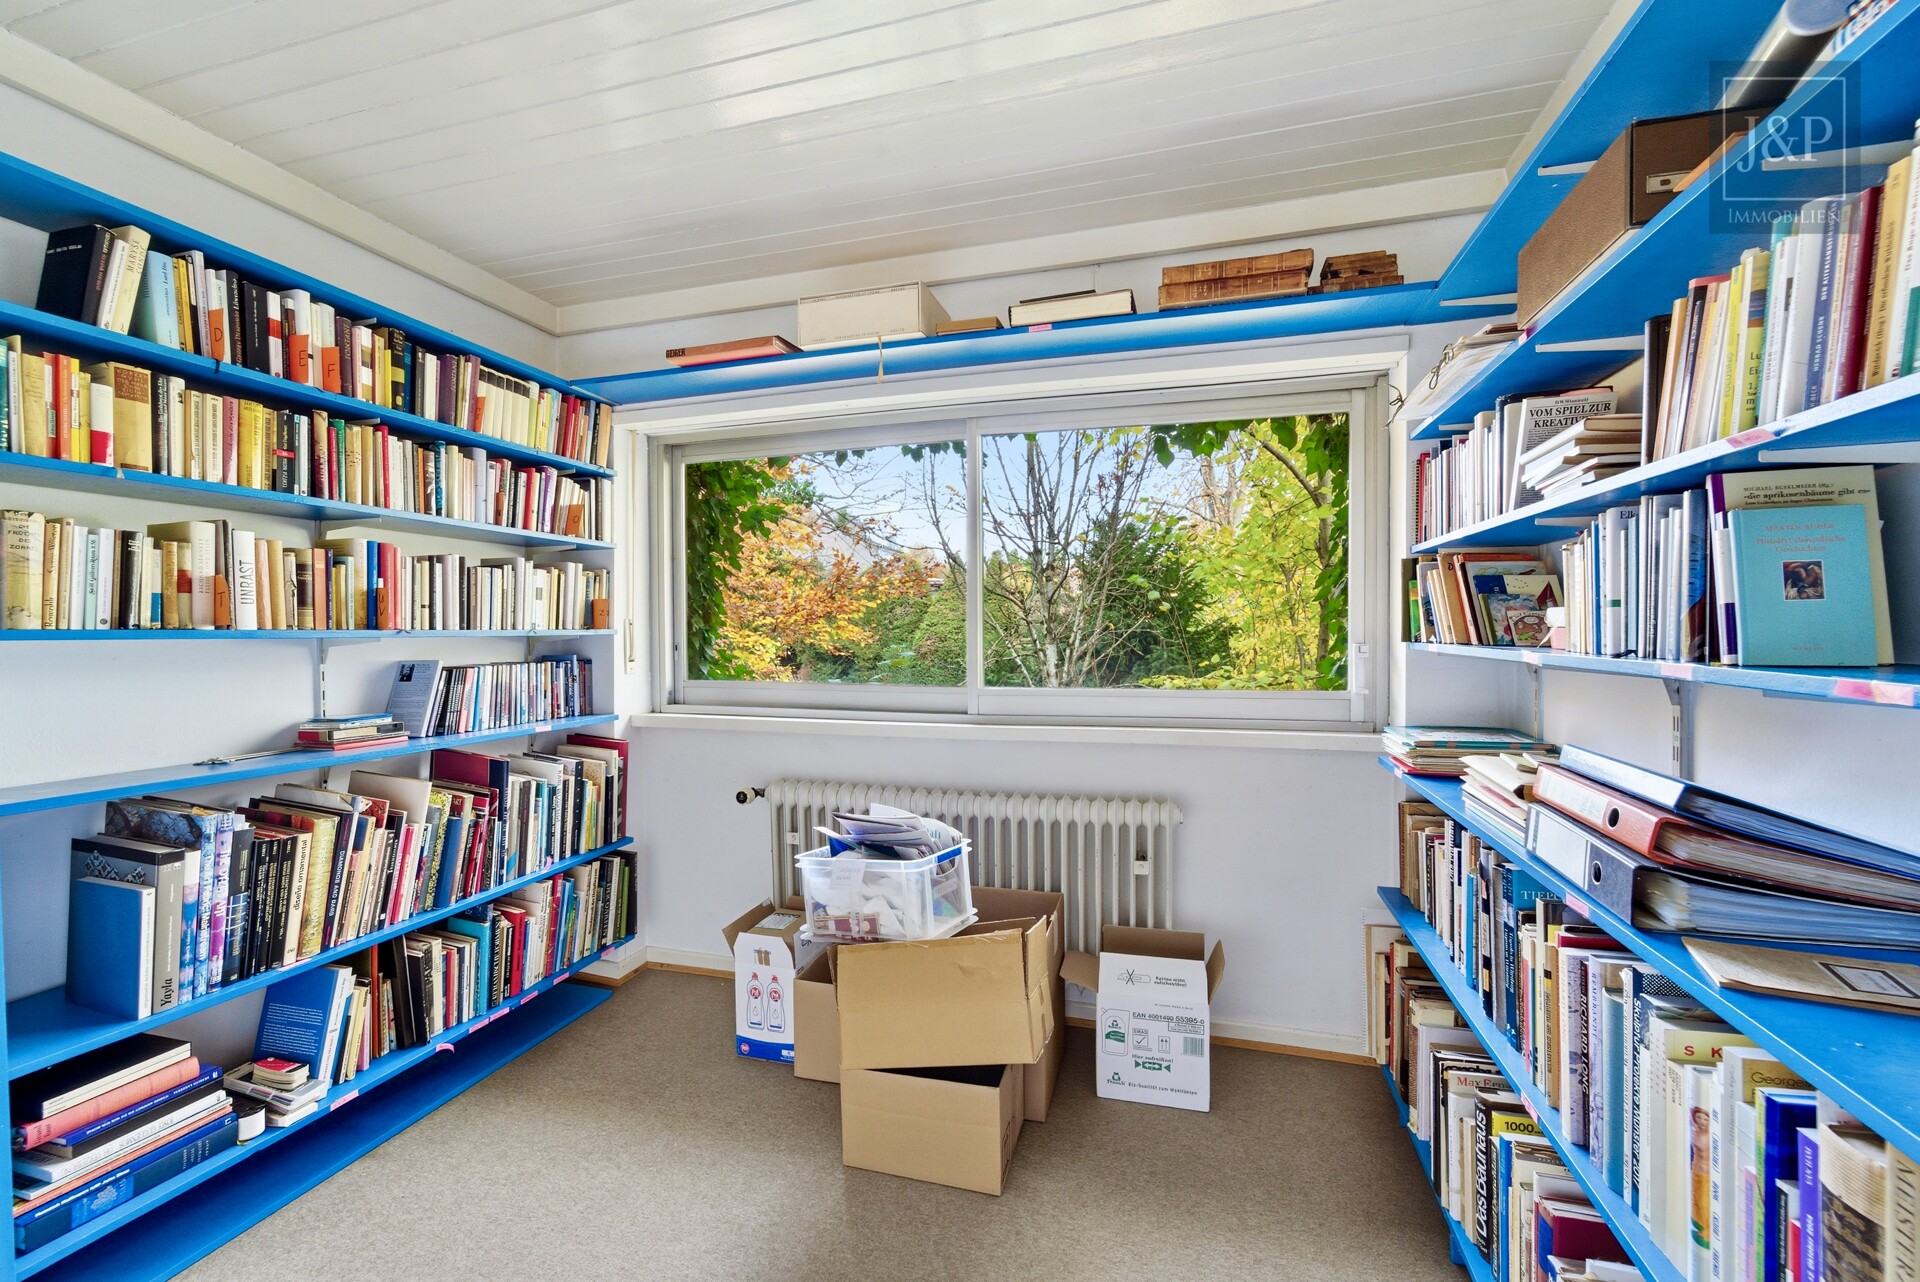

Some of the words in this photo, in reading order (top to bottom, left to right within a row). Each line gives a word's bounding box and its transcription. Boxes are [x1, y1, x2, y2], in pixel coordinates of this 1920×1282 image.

[127, 239, 140, 273] MARYSE
[1529, 407, 1553, 417] VOM
[1585, 403, 1611, 412] ZUR
[1838, 489, 1855, 497] gibt
[239, 559, 254, 605] UNRAST
[297, 839, 307, 883] ornamental
[293, 885, 304, 910] diseño
[160, 977, 174, 1007] Yayla
[1132, 1011, 1146, 1019] EAN
[1580, 994, 1588, 1054] RICHARD
[1633, 997, 1642, 1052] Skulptur
[1684, 1046, 1695, 1056] S
[1457, 1076, 1481, 1086] Max
[1475, 1111, 1487, 1196] Bauhaus
[1475, 1198, 1488, 1238] Das
[1896, 1160, 1916, 1282] MEISTER
